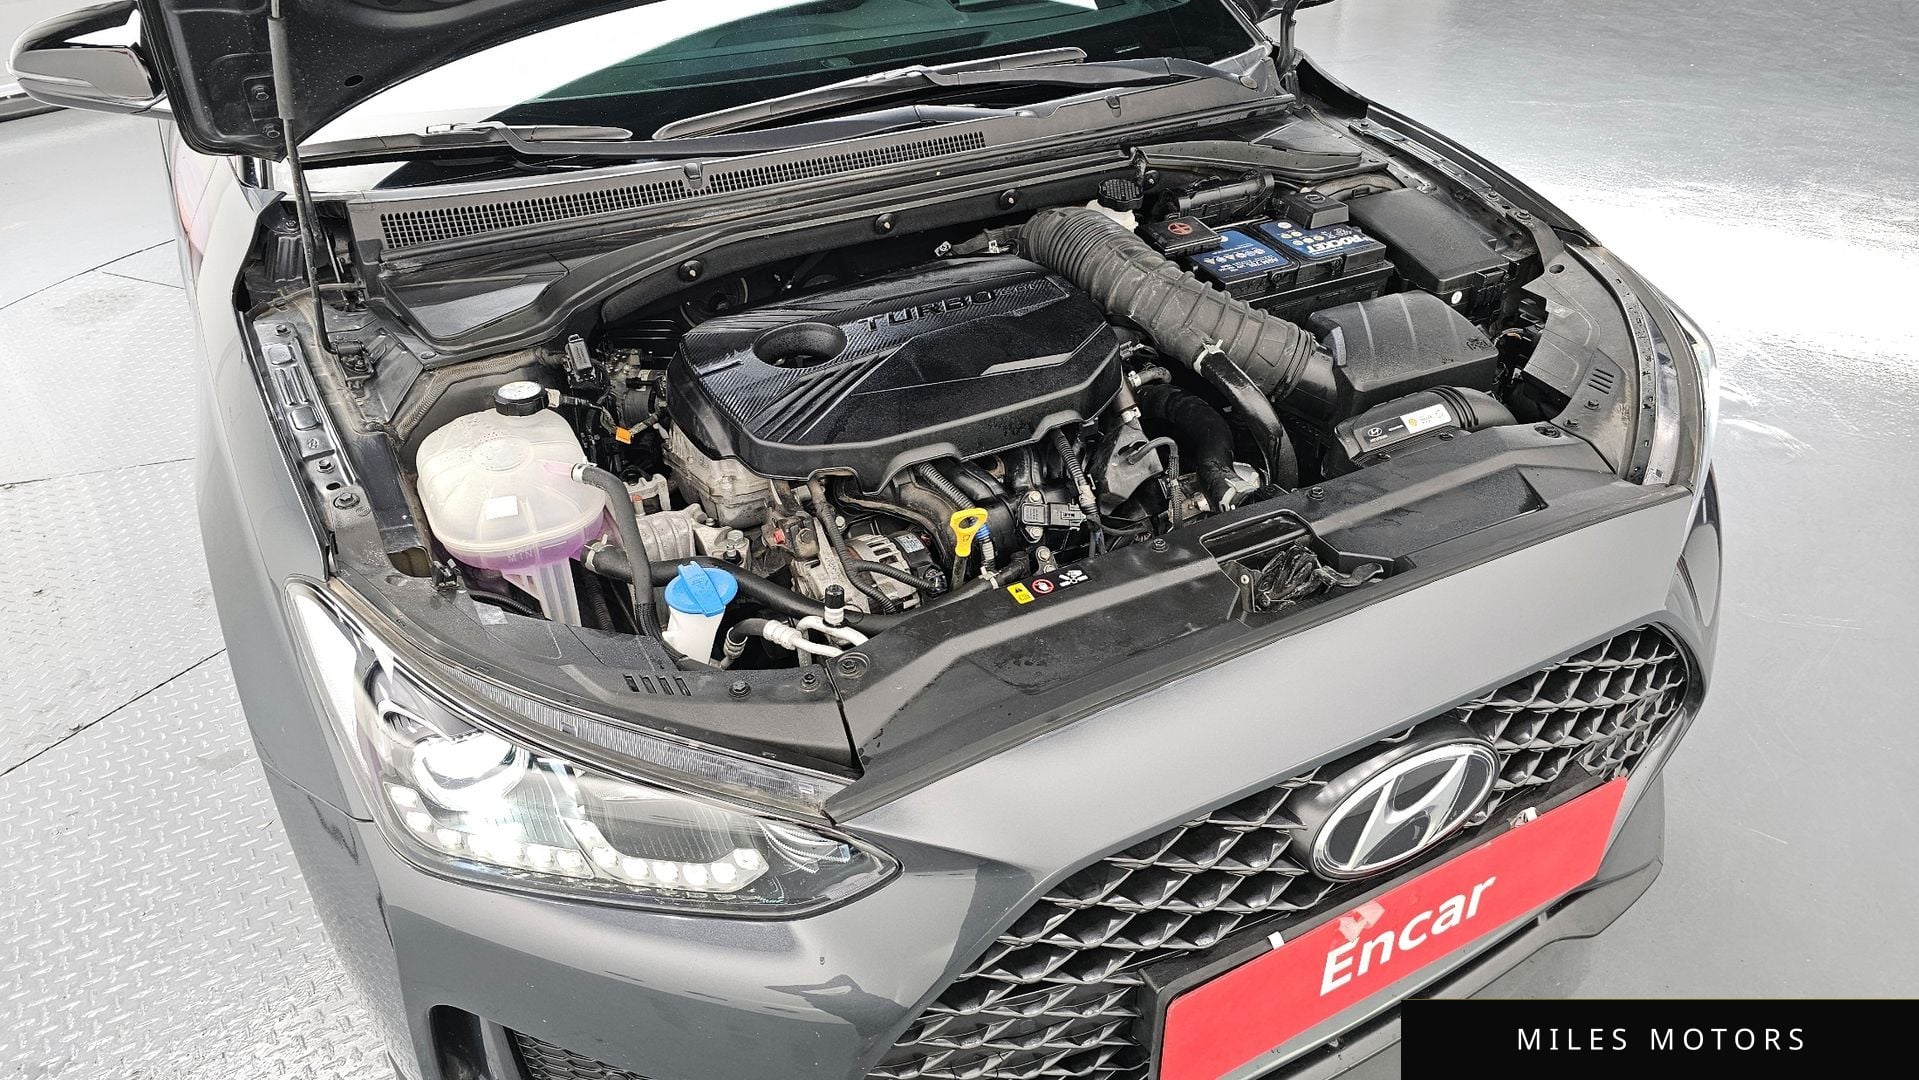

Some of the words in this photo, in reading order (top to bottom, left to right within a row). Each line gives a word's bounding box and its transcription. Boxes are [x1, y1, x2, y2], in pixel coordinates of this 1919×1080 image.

[1307, 235, 1364, 253] ROCKET
[858, 290, 995, 331] TURBO
[1320, 876, 1496, 997] Encar
